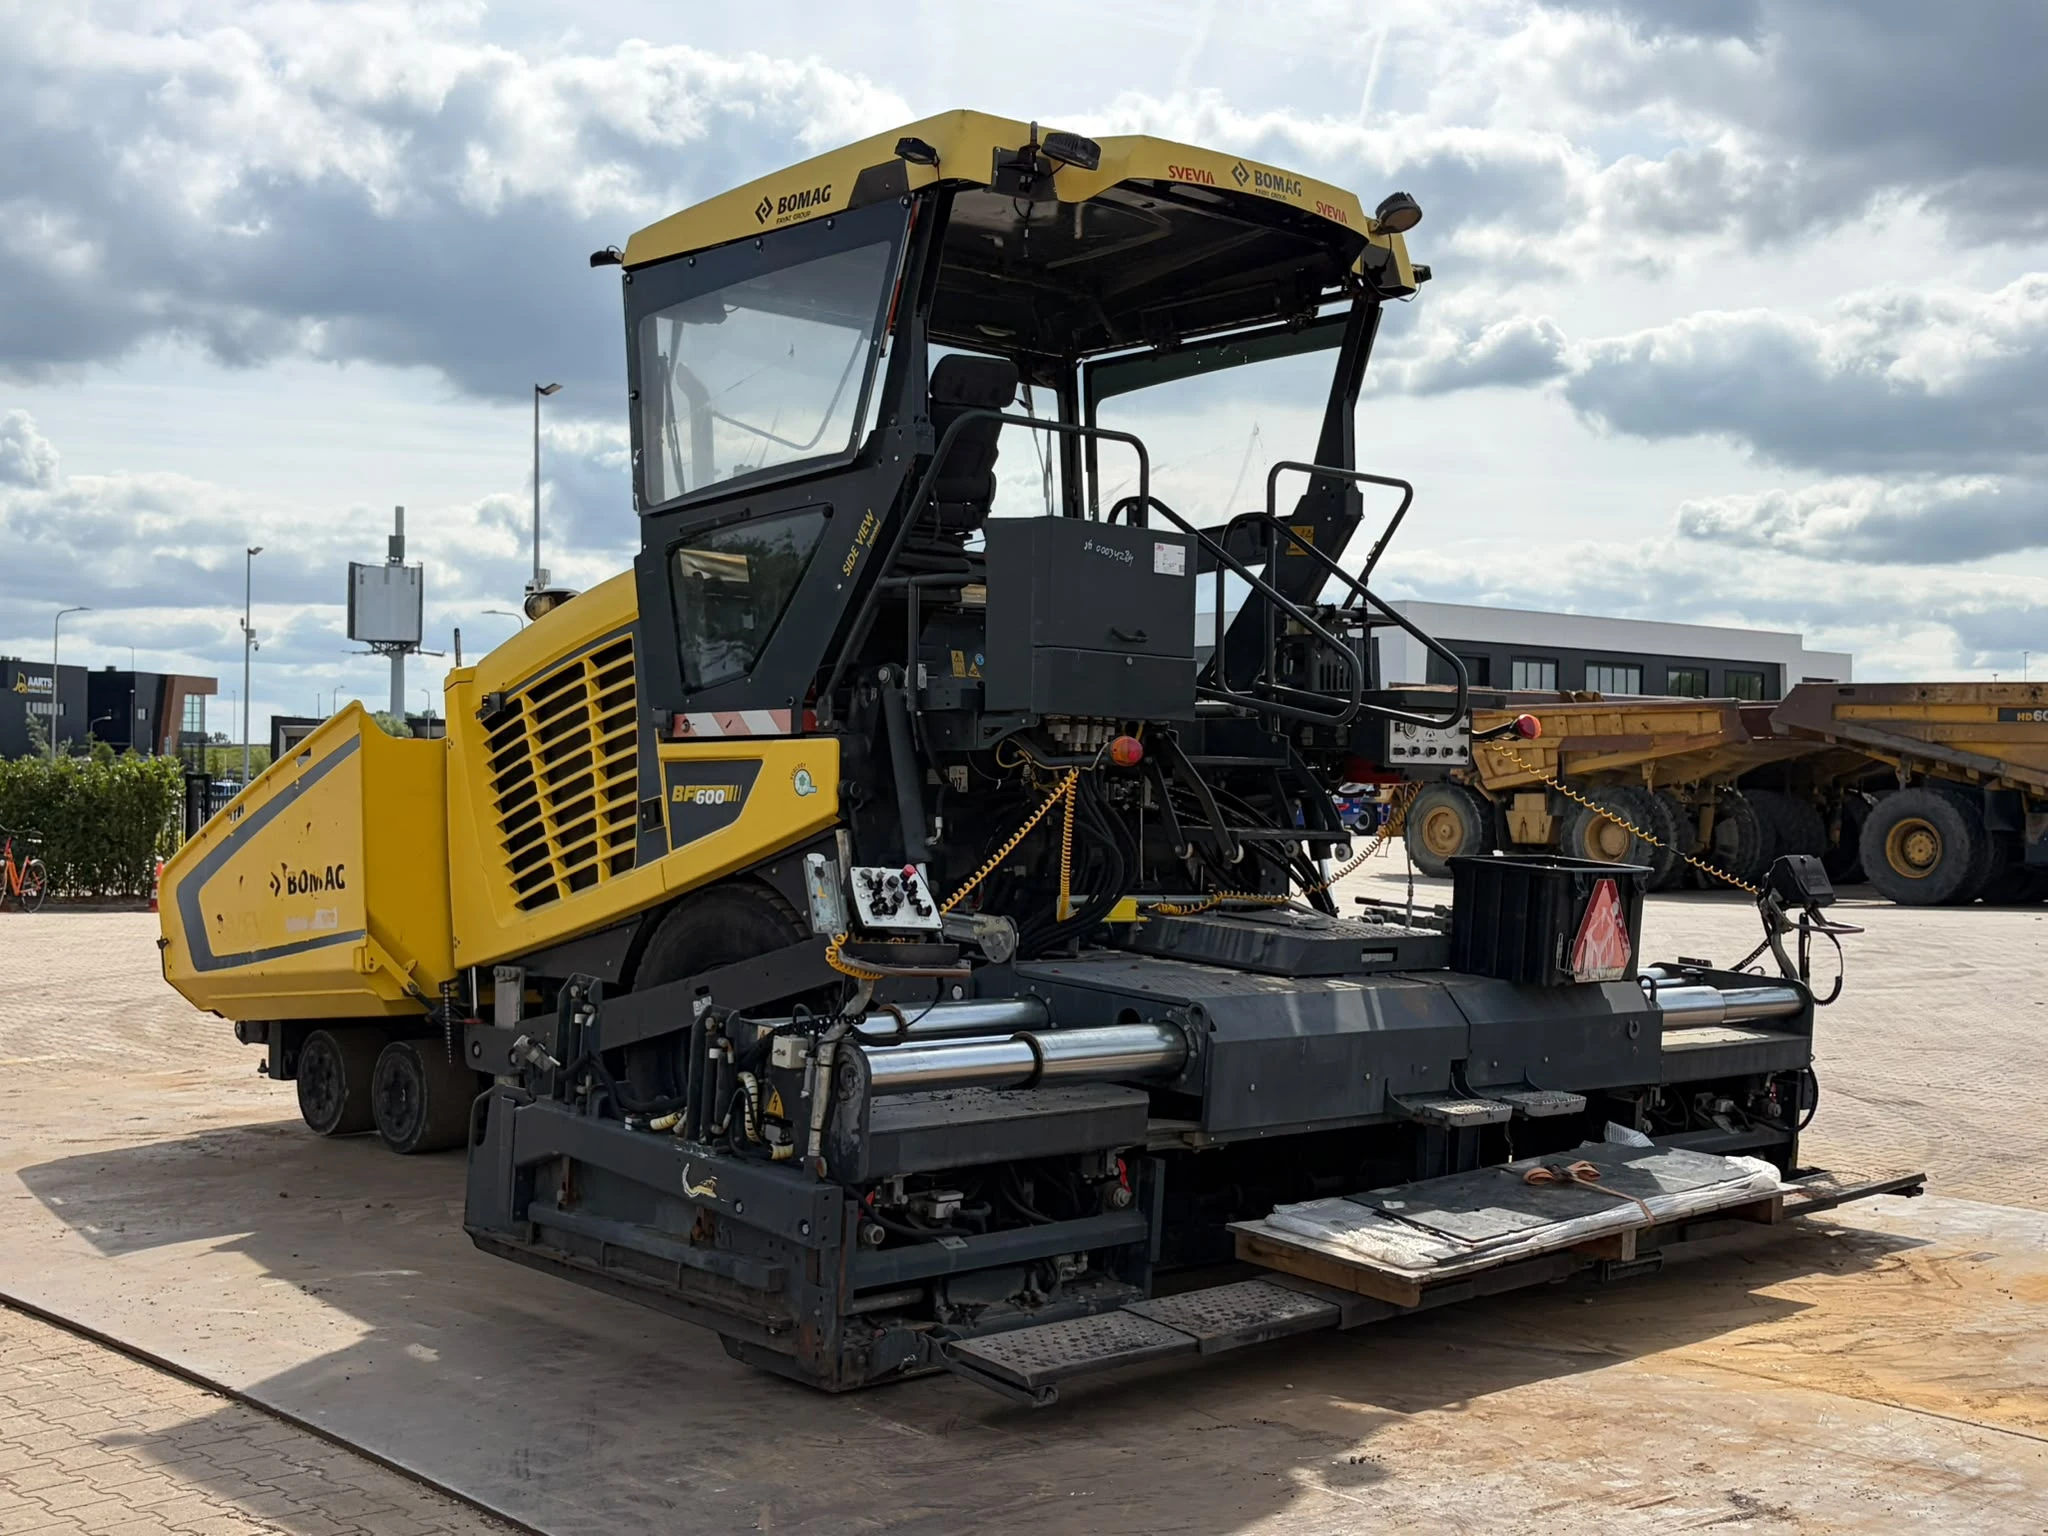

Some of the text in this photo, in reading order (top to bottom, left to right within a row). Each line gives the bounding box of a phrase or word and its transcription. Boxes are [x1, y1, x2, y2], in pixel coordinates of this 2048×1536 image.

[1168, 165, 1215, 185] SVEVIA
[1254, 169, 1302, 197] BOMAG
[777, 184, 832, 215] BOMAG
[1315, 200, 1348, 225] SVEVIA
[842, 508, 875, 577] SIDE VIEW
[27, 676, 53, 688] AARTS
[671, 785, 727, 805] BF600
[287, 863, 346, 896] BOMAG
